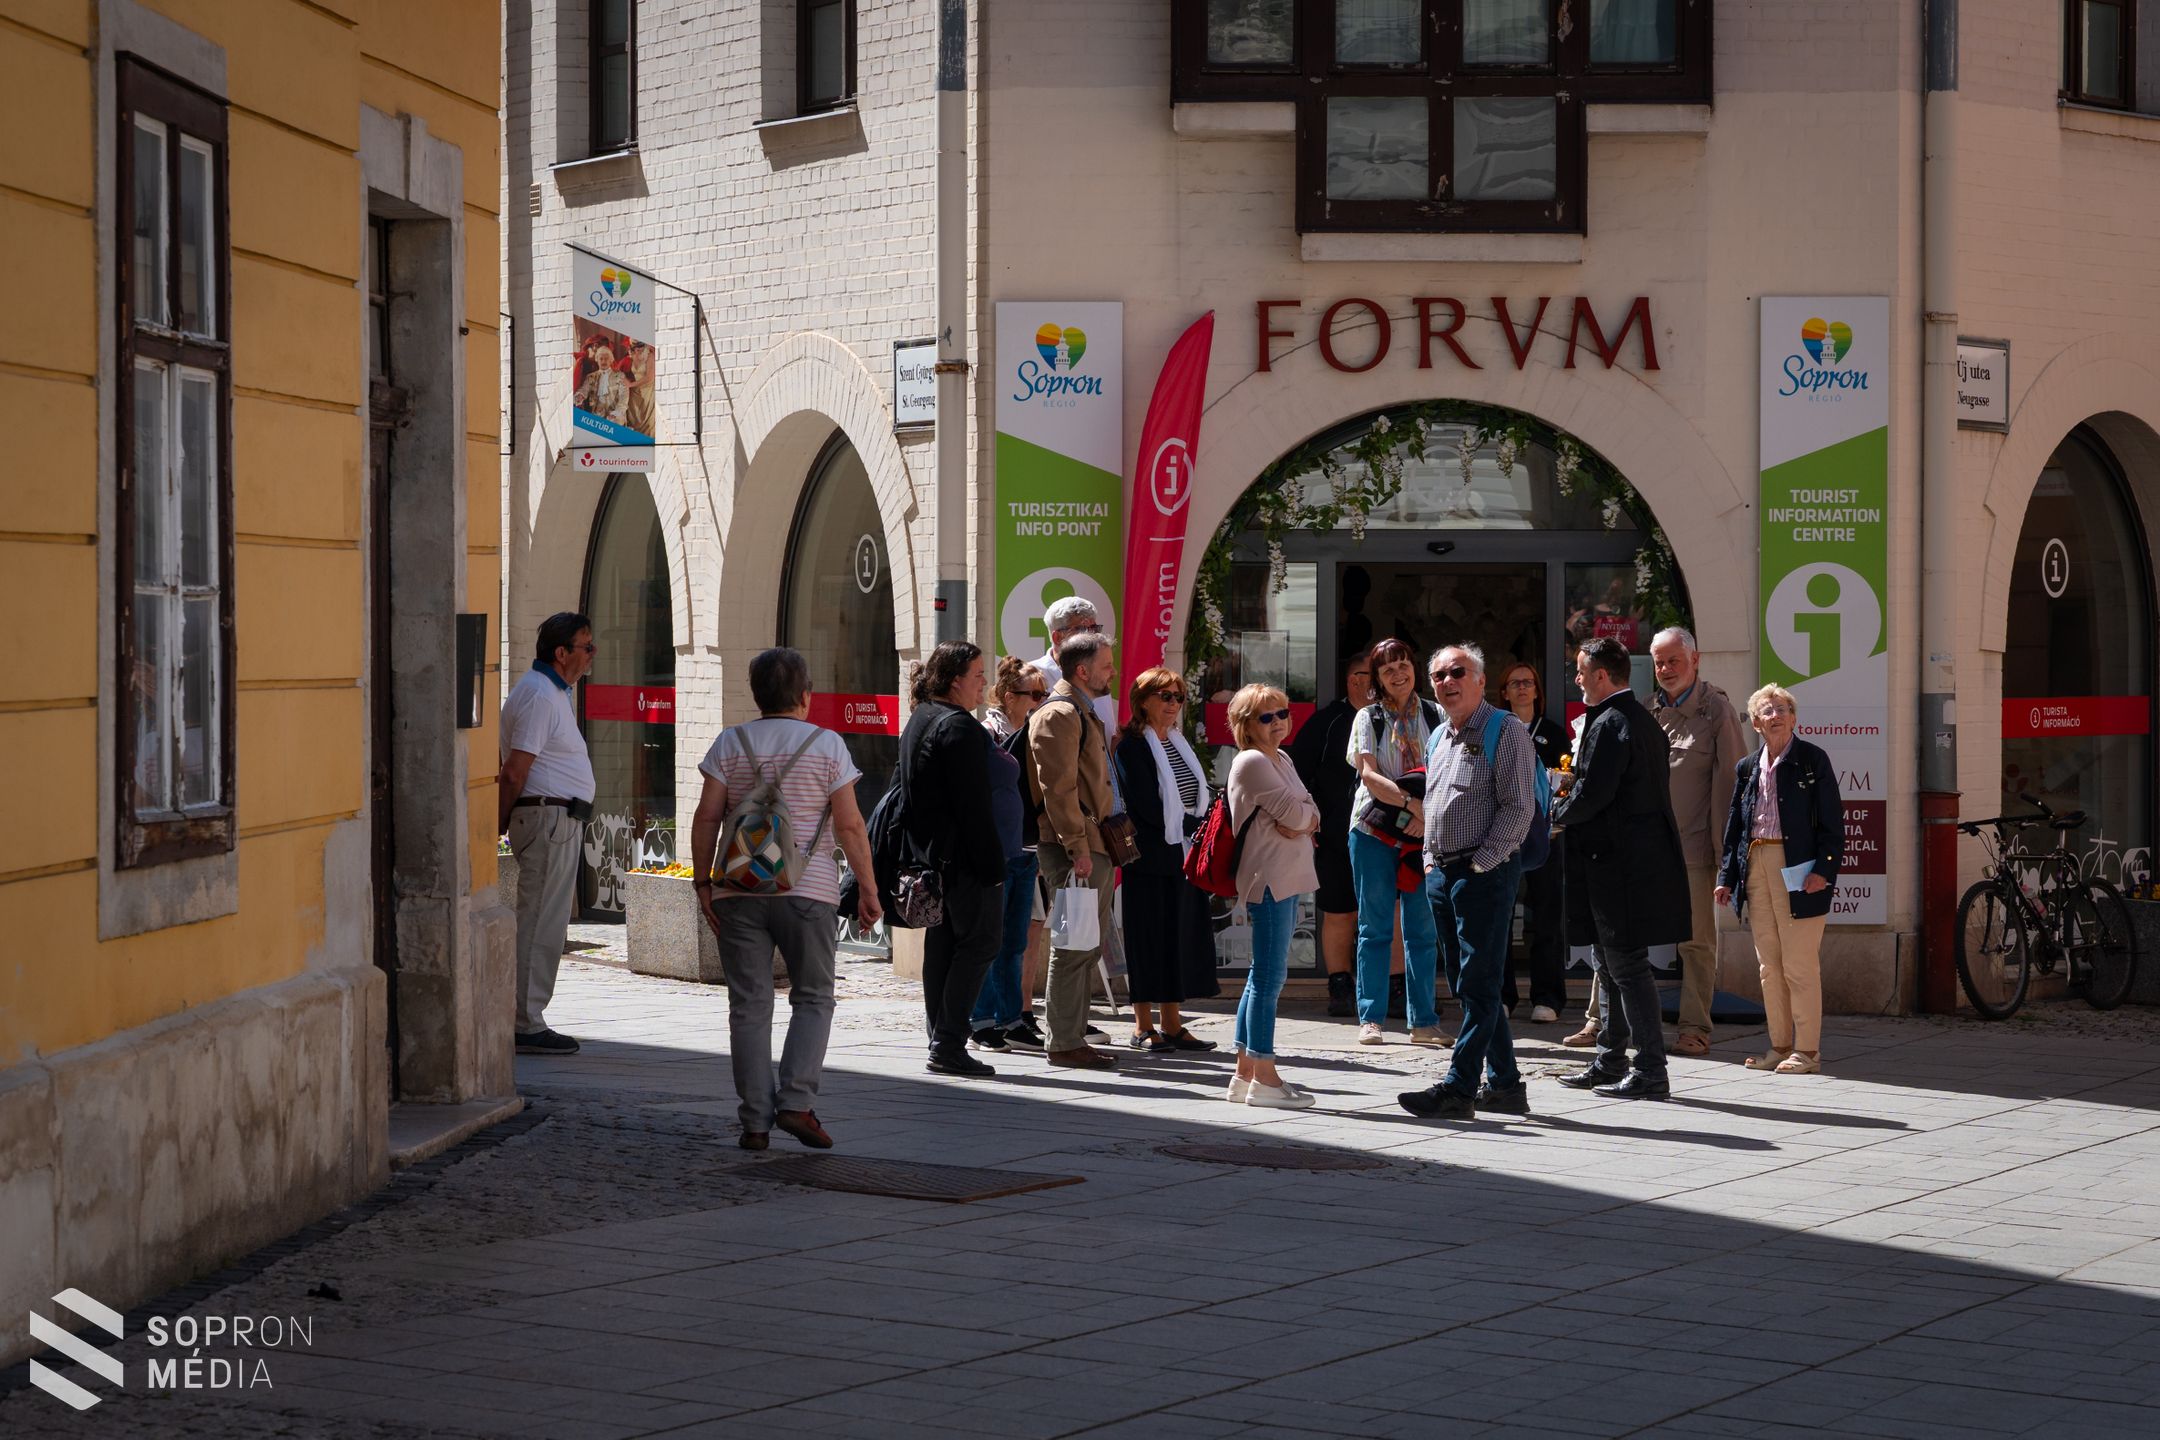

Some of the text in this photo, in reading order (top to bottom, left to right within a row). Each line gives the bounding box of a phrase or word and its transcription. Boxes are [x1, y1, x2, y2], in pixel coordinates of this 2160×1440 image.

[587, 290, 641, 317] Sopron
[1256, 296, 1661, 373] FORVM
[899, 365, 915, 383] Szent
[1779, 354, 1868, 396] Sopron
[1970, 362, 1991, 380] utca
[1013, 360, 1103, 402] Sopron
[1957, 390, 1990, 410] Neugasse
[599, 457, 649, 467] tourinform
[1790, 489, 1859, 504] TOURIST
[1008, 502, 1109, 517] TURISZTIKAI
[1768, 508, 1880, 523] INFORMATION
[1016, 522, 1101, 536] INFO PONT
[1793, 527, 1856, 542] CENTRE
[855, 703, 877, 713] TURISTA
[2043, 706, 2068, 716] TURISTA
[855, 712, 888, 725] INFORMÁCIÓ
[2043, 714, 2081, 728] INFORMÁCIÓ
[1798, 723, 1879, 735] tourinform
[1853, 810, 1869, 821] OF
[1844, 887, 1871, 898] YOU
[1833, 903, 1859, 913] DAY
